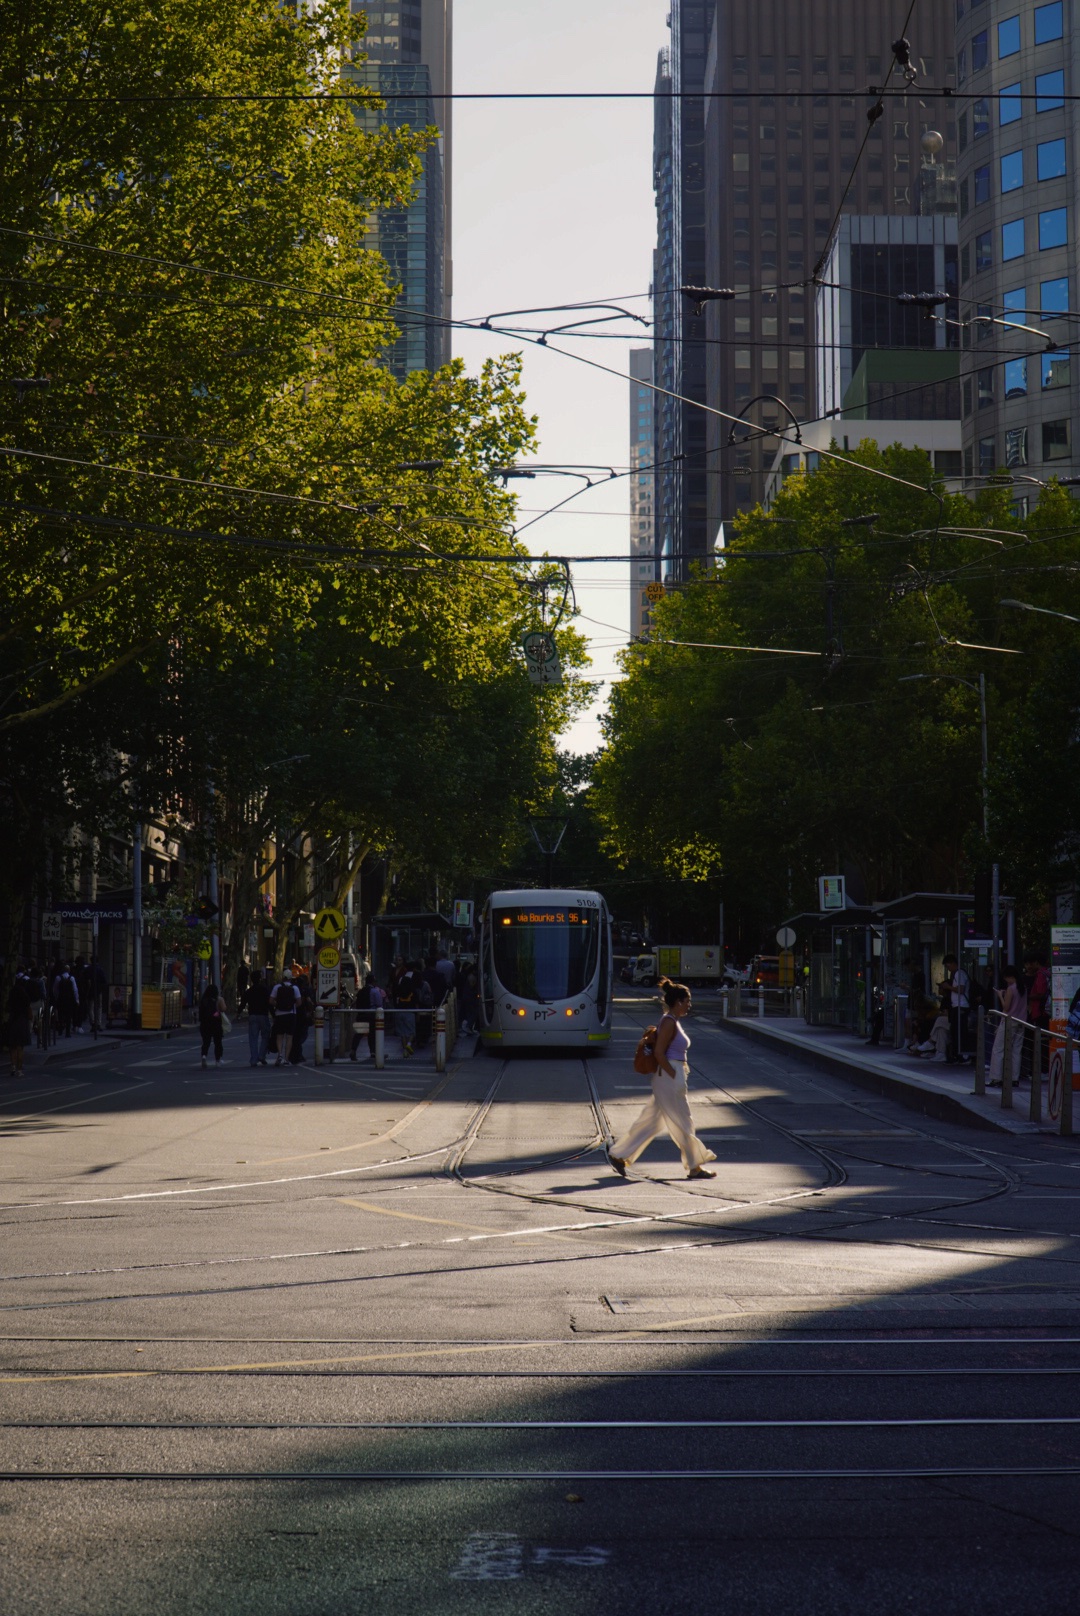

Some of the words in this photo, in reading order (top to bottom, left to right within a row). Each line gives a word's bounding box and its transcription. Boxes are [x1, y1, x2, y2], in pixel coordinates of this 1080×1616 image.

[576, 899, 597, 907] 5106
[517, 912, 528, 922] via
[529, 912, 555, 922] Bourke
[556, 913, 565, 922] St
[568, 913, 579, 922] 96
